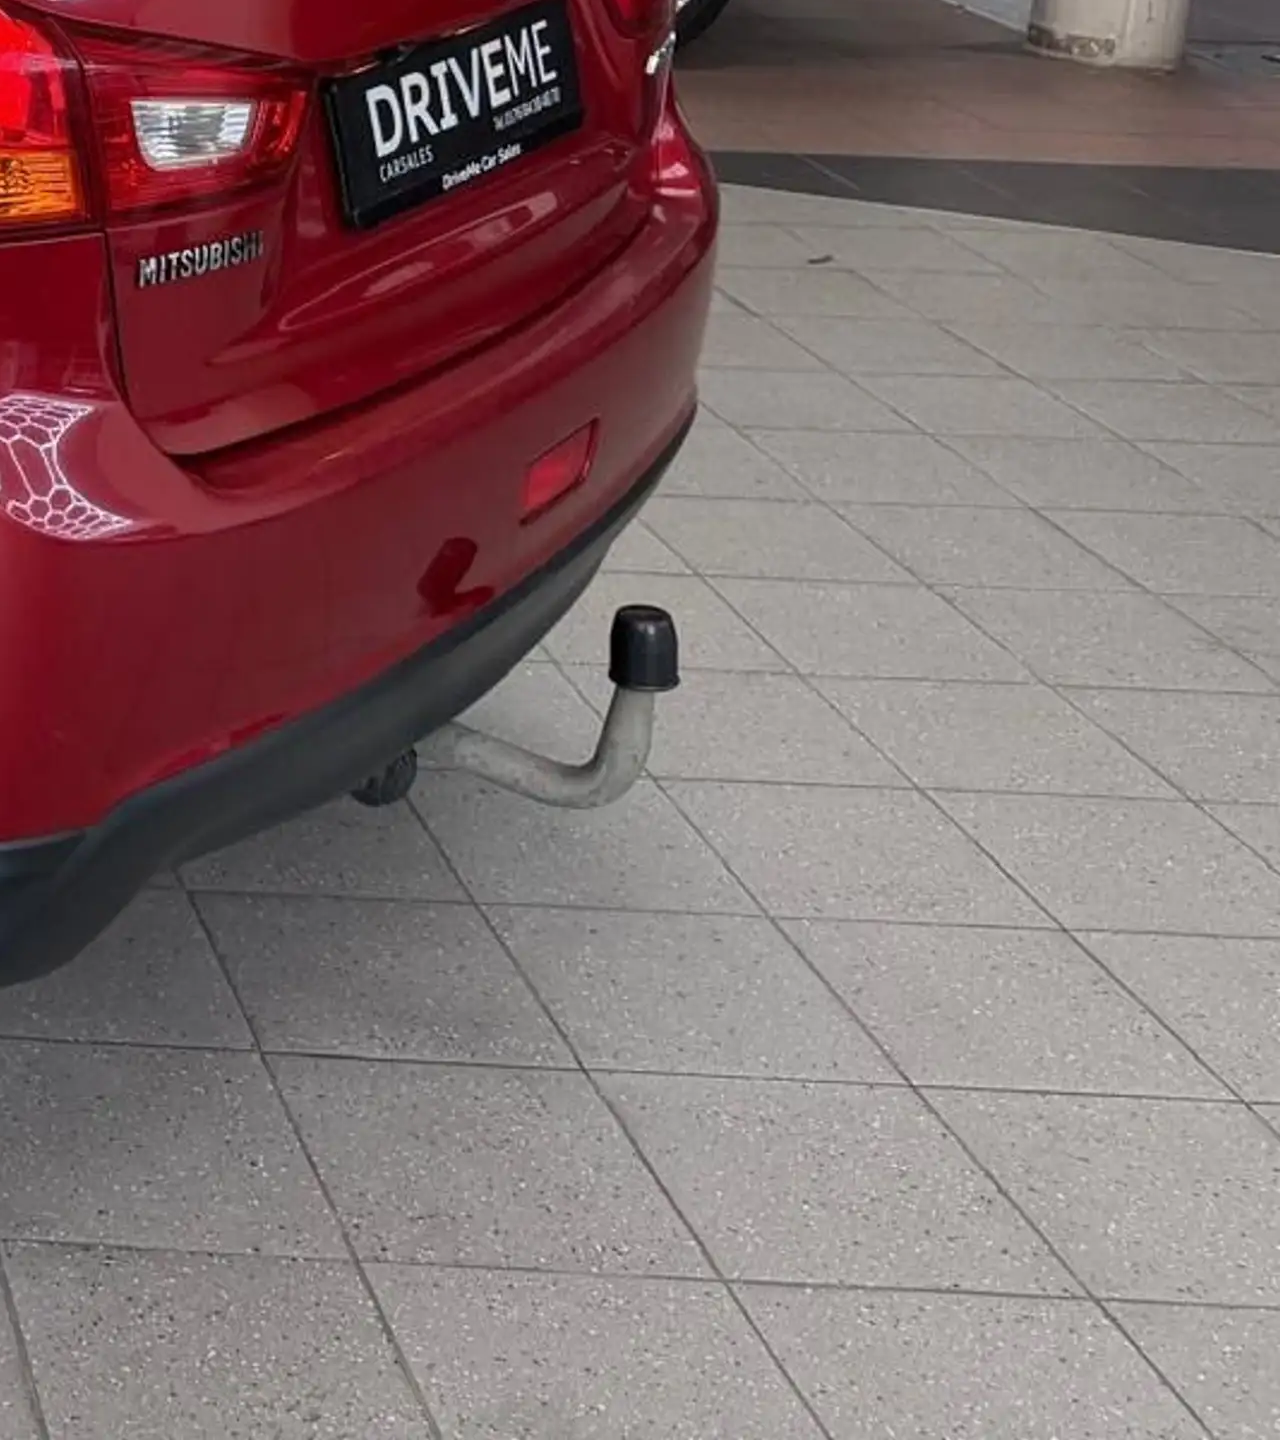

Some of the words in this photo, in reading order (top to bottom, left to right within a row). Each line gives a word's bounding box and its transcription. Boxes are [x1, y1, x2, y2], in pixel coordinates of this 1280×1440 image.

[365, 18, 558, 159] DRIVEME
[379, 144, 435, 184] CARSALES
[137, 229, 264, 289] MITSUBISHI
